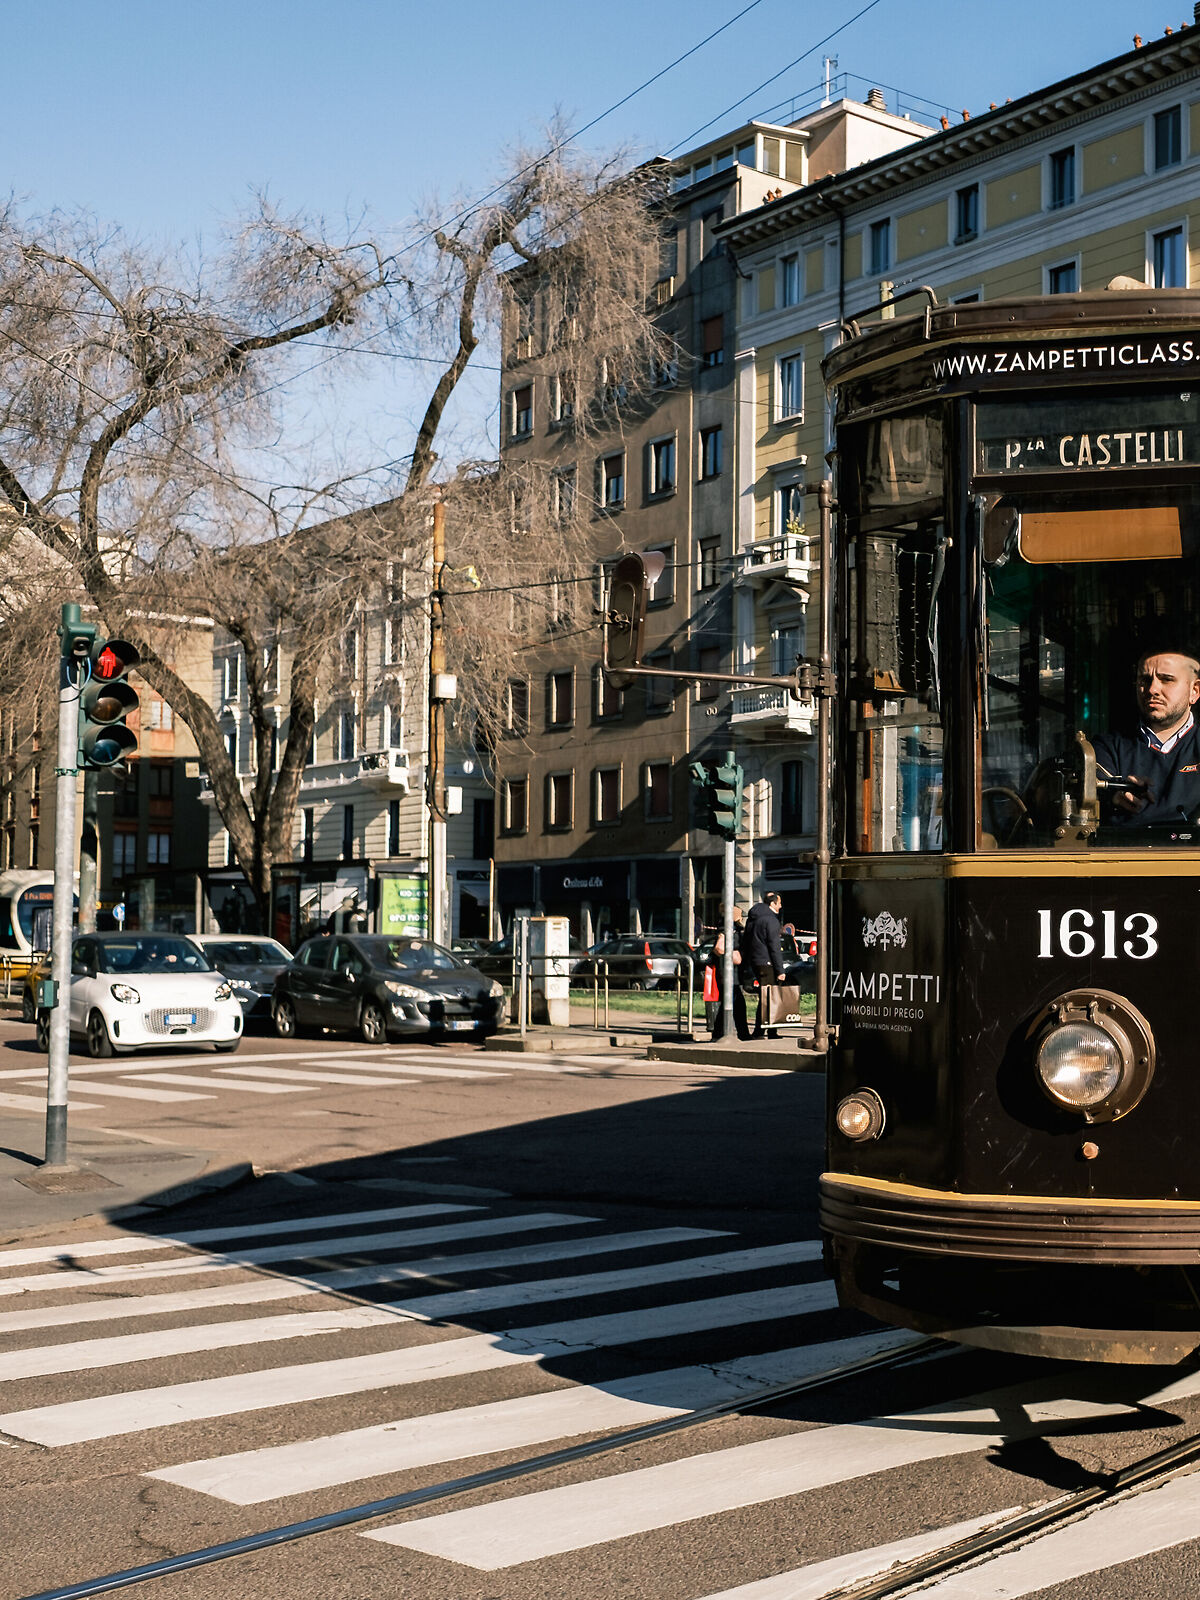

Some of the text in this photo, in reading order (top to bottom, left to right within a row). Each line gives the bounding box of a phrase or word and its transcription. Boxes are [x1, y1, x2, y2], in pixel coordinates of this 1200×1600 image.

[1059, 430, 1184, 467] CASTELLI
[1037, 908, 1159, 960] 1613
[830, 971, 941, 1003] ZAMPETTI
[843, 1004, 924, 1020] IMMOBILI DI PREGIO
